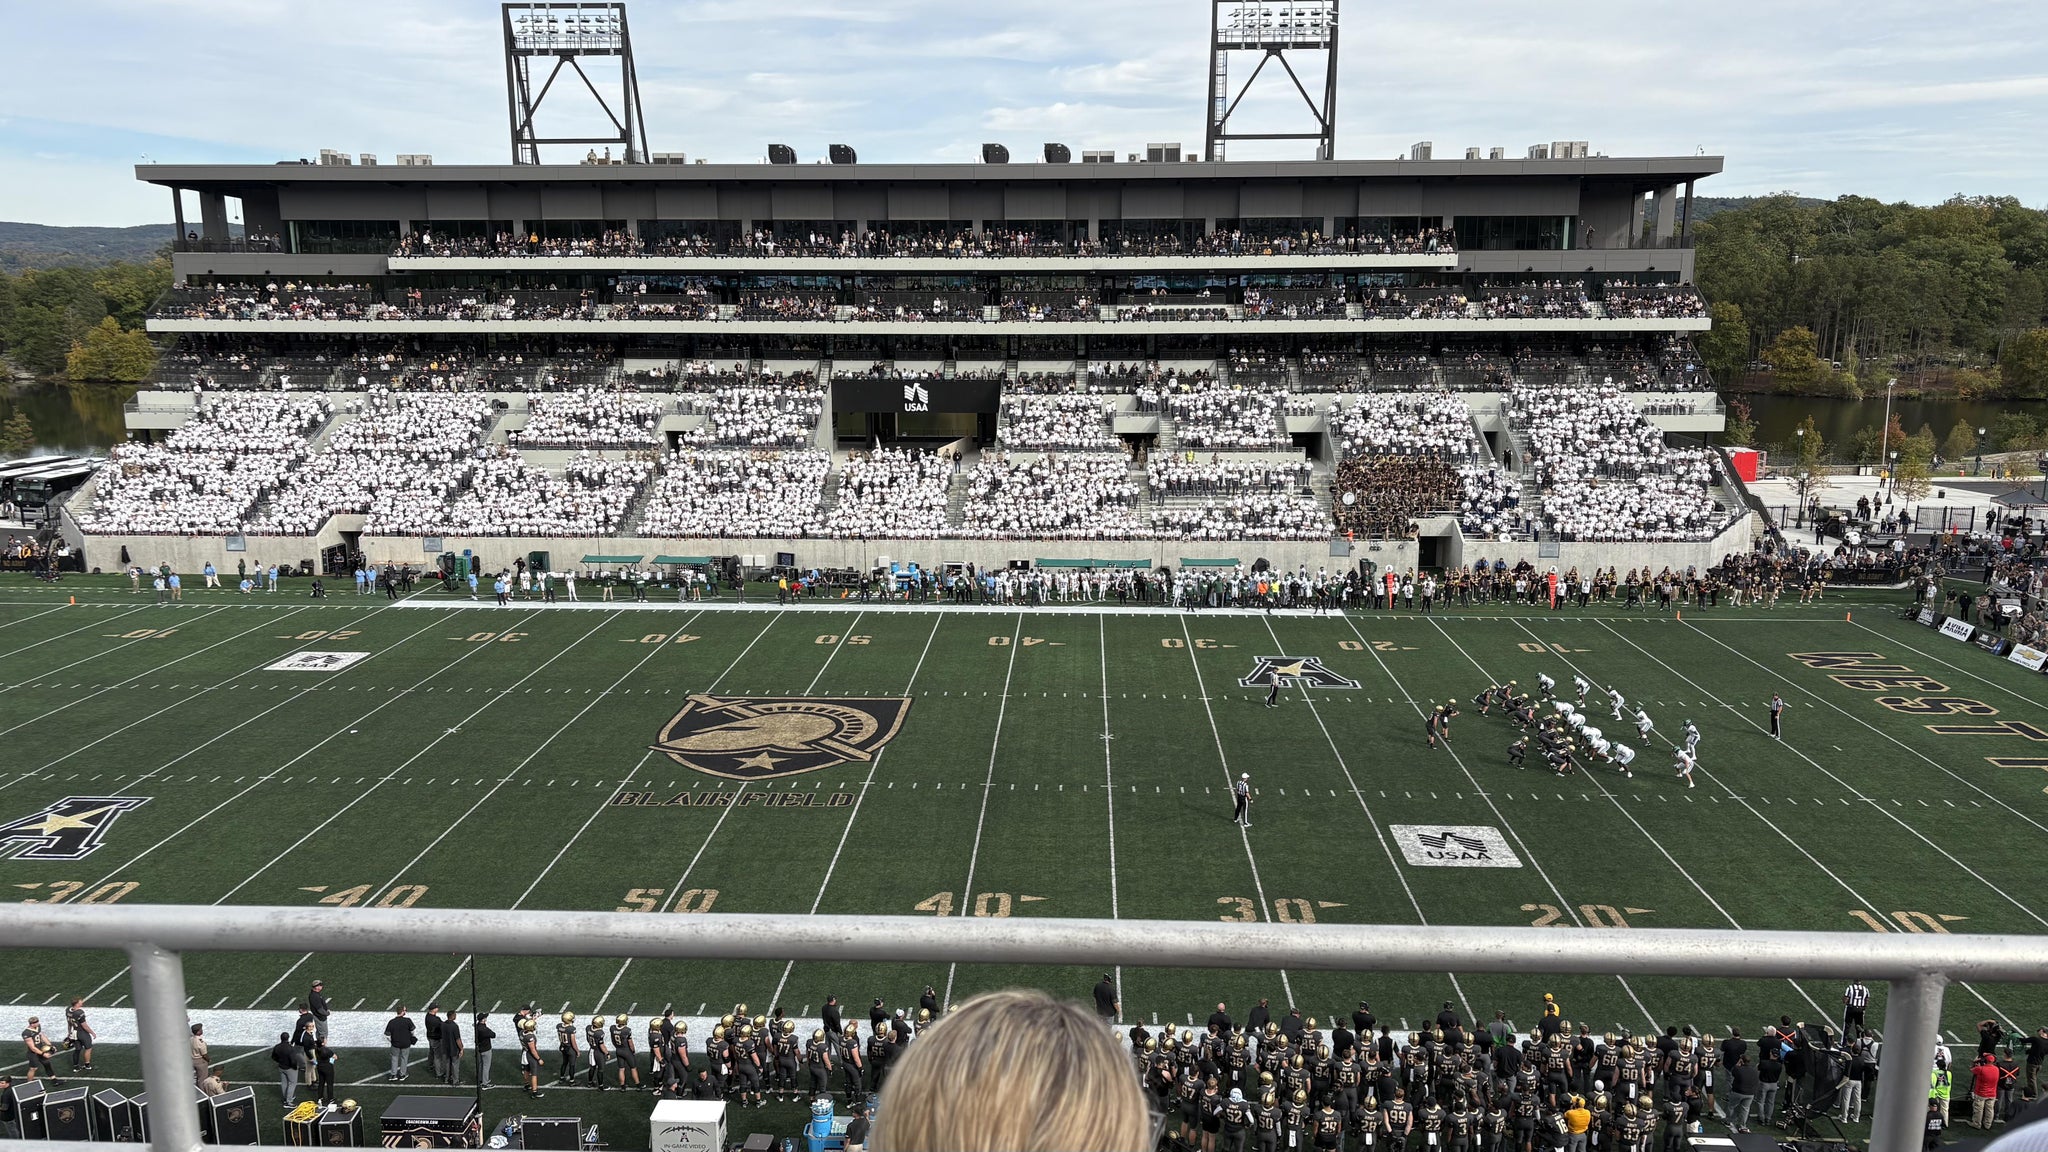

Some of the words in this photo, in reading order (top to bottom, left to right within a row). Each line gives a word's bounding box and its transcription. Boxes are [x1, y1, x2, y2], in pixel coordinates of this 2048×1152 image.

[904, 402, 929, 412] USAA
[294, 630, 361, 640] 20
[465, 632, 529, 642] 30
[639, 633, 701, 643] 40
[814, 635, 872, 645] 50
[988, 636, 1045, 646] 40
[1161, 637, 1218, 648] 30
[1338, 641, 1399, 652] 20
[1517, 642, 1572, 654] 10
[612, 791, 734, 807] BLAIK
[736, 792, 857, 808] FIELD
[1427, 850, 1493, 861] USAA
[318, 884, 429, 908] 40
[616, 888, 720, 913] 50
[913, 891, 1011, 918] 40
[1216, 896, 1317, 924] 30
[1520, 903, 1632, 928] 20
[1847, 910, 1951, 935] 10
[1855, 989, 1862, 999] L
